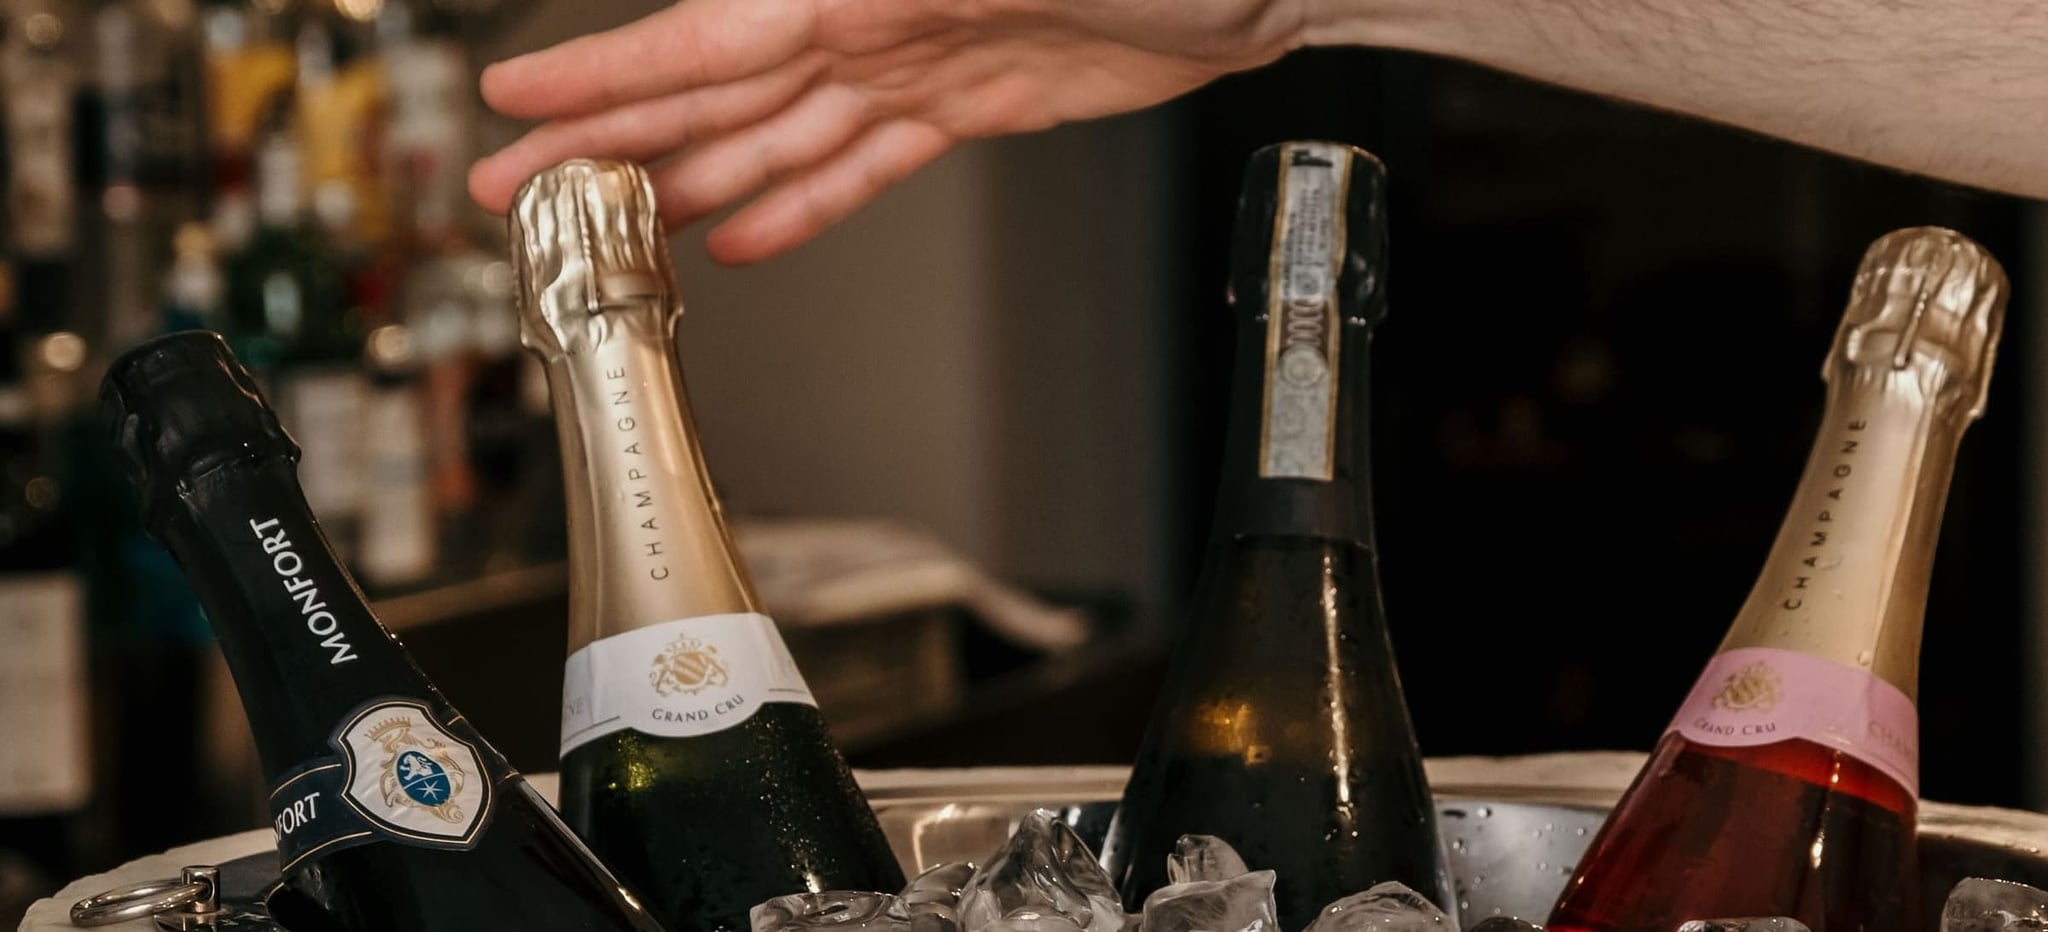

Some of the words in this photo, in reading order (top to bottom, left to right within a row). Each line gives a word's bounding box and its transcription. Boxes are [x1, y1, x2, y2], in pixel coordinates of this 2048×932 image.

[607, 366, 669, 581] CHAMPAGNE
[1784, 419, 1867, 610] CHAMPAGNE
[249, 518, 358, 665] MONFORT
[652, 708, 709, 723] GRAND
[715, 694, 745, 715] CRU
[1742, 722, 1776, 736] CRU
